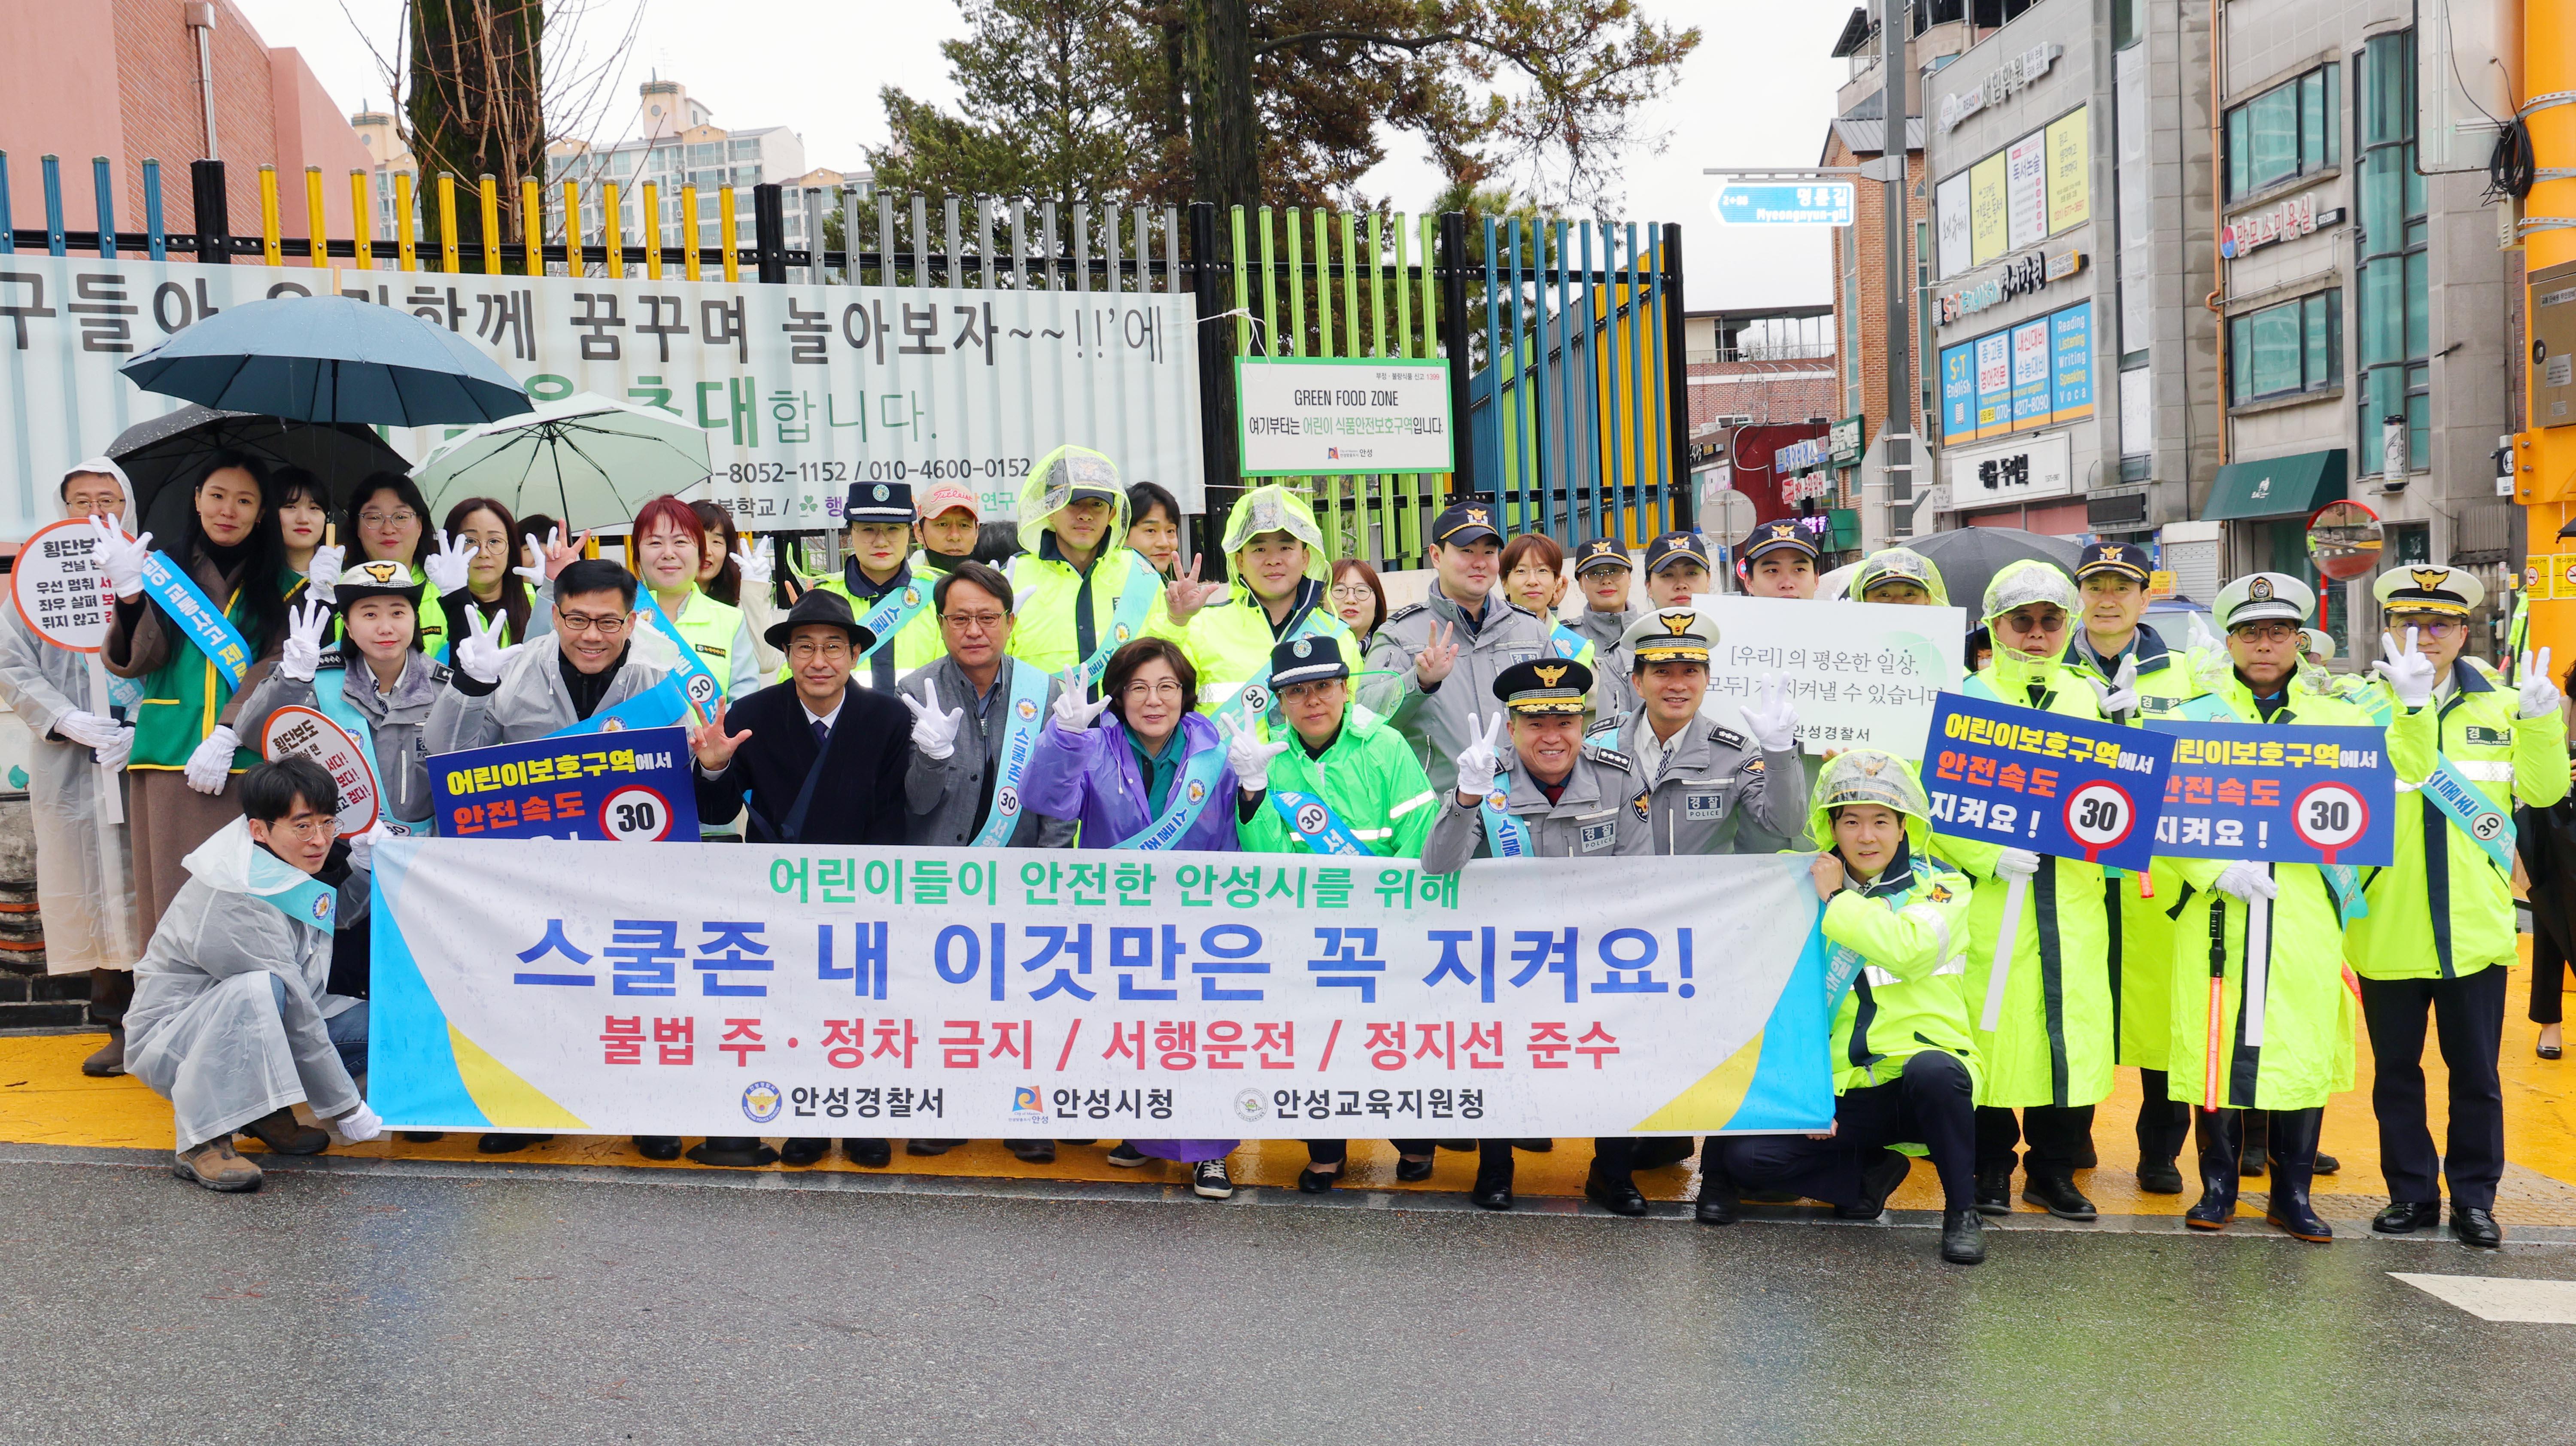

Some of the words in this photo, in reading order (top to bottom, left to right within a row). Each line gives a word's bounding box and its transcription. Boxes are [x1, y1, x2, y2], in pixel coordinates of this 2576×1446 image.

[2013, 152, 2040, 181] 독서논술
[1756, 209, 1847, 222] Myeongnyun-gil
[2236, 194, 2310, 253] 맘모스미용실
[1999, 252, 2045, 302] 영어학원
[570, 292, 748, 364] 꿈꾸며
[2058, 316, 2085, 334] Reading
[2017, 326, 2045, 352] 내신대비
[2058, 334, 2085, 351] Listening
[2018, 354, 2045, 380] 수능대비
[2059, 351, 2086, 368] Writing
[1391, 373, 1412, 381] 불량식품
[1981, 365, 2006, 390] 영어전문
[2060, 369, 2086, 387] Speaking
[1294, 389, 1331, 406] GREEN
[1336, 390, 1366, 406] FOOD
[1371, 390, 1399, 407] ZONE
[1947, 379, 1971, 398] English
[1249, 416, 1300, 435] 여기부터는
[1303, 416, 1333, 435] 어린이
[1336, 416, 1444, 435] 식품안전보호구역입니다.
[1359, 449, 1373, 458] 안성
[1785, 440, 1816, 471] 제이비에스
[705, 462, 846, 484] -8052-1152
[870, 458, 1030, 480] 010-4600-0152
[931, 487, 973, 504] Titleist
[61, 560, 85, 573] 건널
[37, 580, 64, 594] 우선
[67, 577, 95, 591] 멈춰
[39, 598, 66, 612] 좌우
[70, 594, 97, 609] 살펴
[42, 615, 69, 630] 뛰지
[74, 611, 100, 626] 않고
[164, 584, 229, 647] 교통사고
[1813, 650, 1871, 672] 평온한
[1877, 652, 1920, 677] 일상,
[691, 679, 711, 699] 30
[1843, 682, 1863, 698] 수
[1245, 690, 1265, 709] 30
[272, 719, 319, 755] 횡단보도
[1794, 724, 1870, 742] 안성경찰서
[2468, 726, 2510, 741] 경찰
[1944, 713, 2154, 775] 어린이보호구역에서
[325, 751, 349, 772] 서다!
[1007, 726, 1030, 784] 스쿨존
[335, 768, 360, 788] 보다!
[447, 749, 673, 796] 어린이보호구역에서
[1936, 750, 2060, 798] 안전속도
[346, 784, 371, 805] 걷다!
[1001, 793, 1016, 810] 30
[1688, 796, 1719, 810] 경찰
[453, 791, 586, 835] 안전속도
[616, 802, 656, 832] 30
[1300, 809, 1323, 829] 30
[1929, 790, 2018, 834] 지켜요
[2079, 798, 2118, 832] 30
[2310, 800, 2349, 832] 30
[1583, 823, 1613, 842] 경찰
[2155, 816, 2244, 847] 지켜요
[2476, 817, 2499, 837] 30
[1585, 837, 1613, 848] POLICE
[770, 858, 996, 905] 어린이들이
[1021, 862, 1157, 906] 안전한
[1176, 864, 1354, 908] 안성시를
[1374, 869, 1461, 909] 위해
[514, 920, 774, 996] 스쿨존
[818, 922, 887, 1000] 내
[935, 923, 1270, 1001] 이것만은
[1308, 928, 1385, 1003] 꼭
[1423, 927, 1695, 1003] 지켜요!
[600, 1016, 693, 1065] 불법
[719, 1019, 766, 1067] 주
[821, 1018, 918, 1069] 정차
[939, 1020, 1032, 1069] 금지
[1103, 1021, 1294, 1070] 서행운전
[1365, 1021, 1504, 1071] 정지선
[1527, 1021, 1619, 1069] 준수
[792, 1088, 942, 1118] 안성경찰서
[1054, 1089, 1173, 1119] 안성시청
[1273, 1089, 1483, 1119] 안성교육지원청
[1032, 1115, 1048, 1124] 안성
